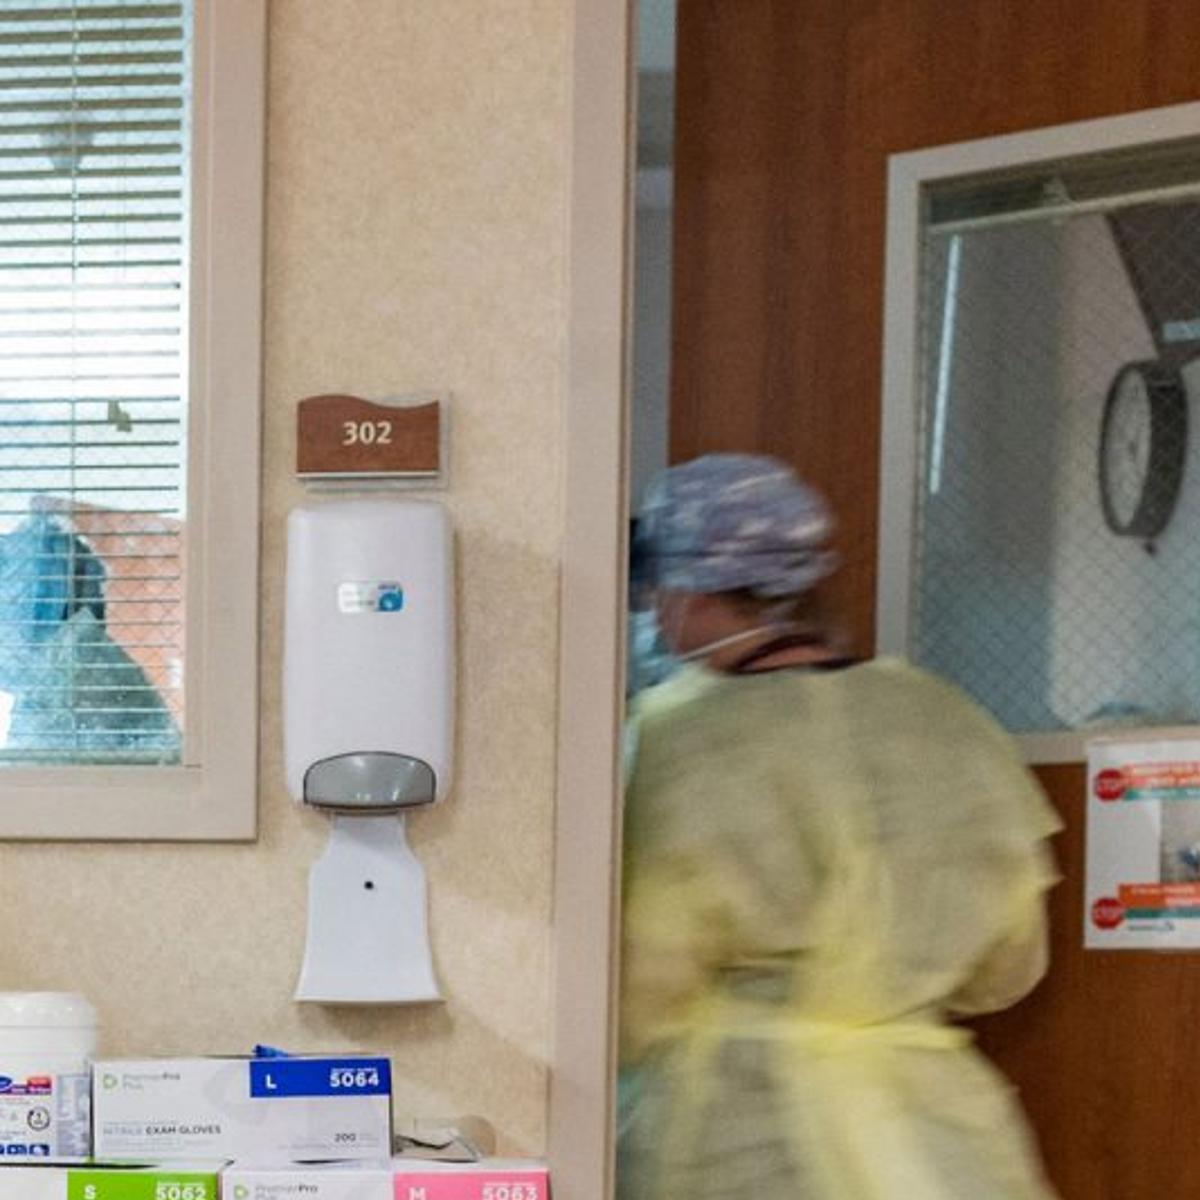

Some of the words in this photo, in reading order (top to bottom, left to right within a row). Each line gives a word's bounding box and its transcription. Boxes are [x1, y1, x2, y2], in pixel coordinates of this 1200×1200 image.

[342, 421, 392, 446] 302
[265, 1074, 277, 1089] L
[329, 1071, 379, 1087] 5064
[145, 1126, 176, 1134] EXAM
[179, 1125, 221, 1134] GLOVES
[335, 1133, 356, 1142] 200
[84, 1184, 97, 1200] S
